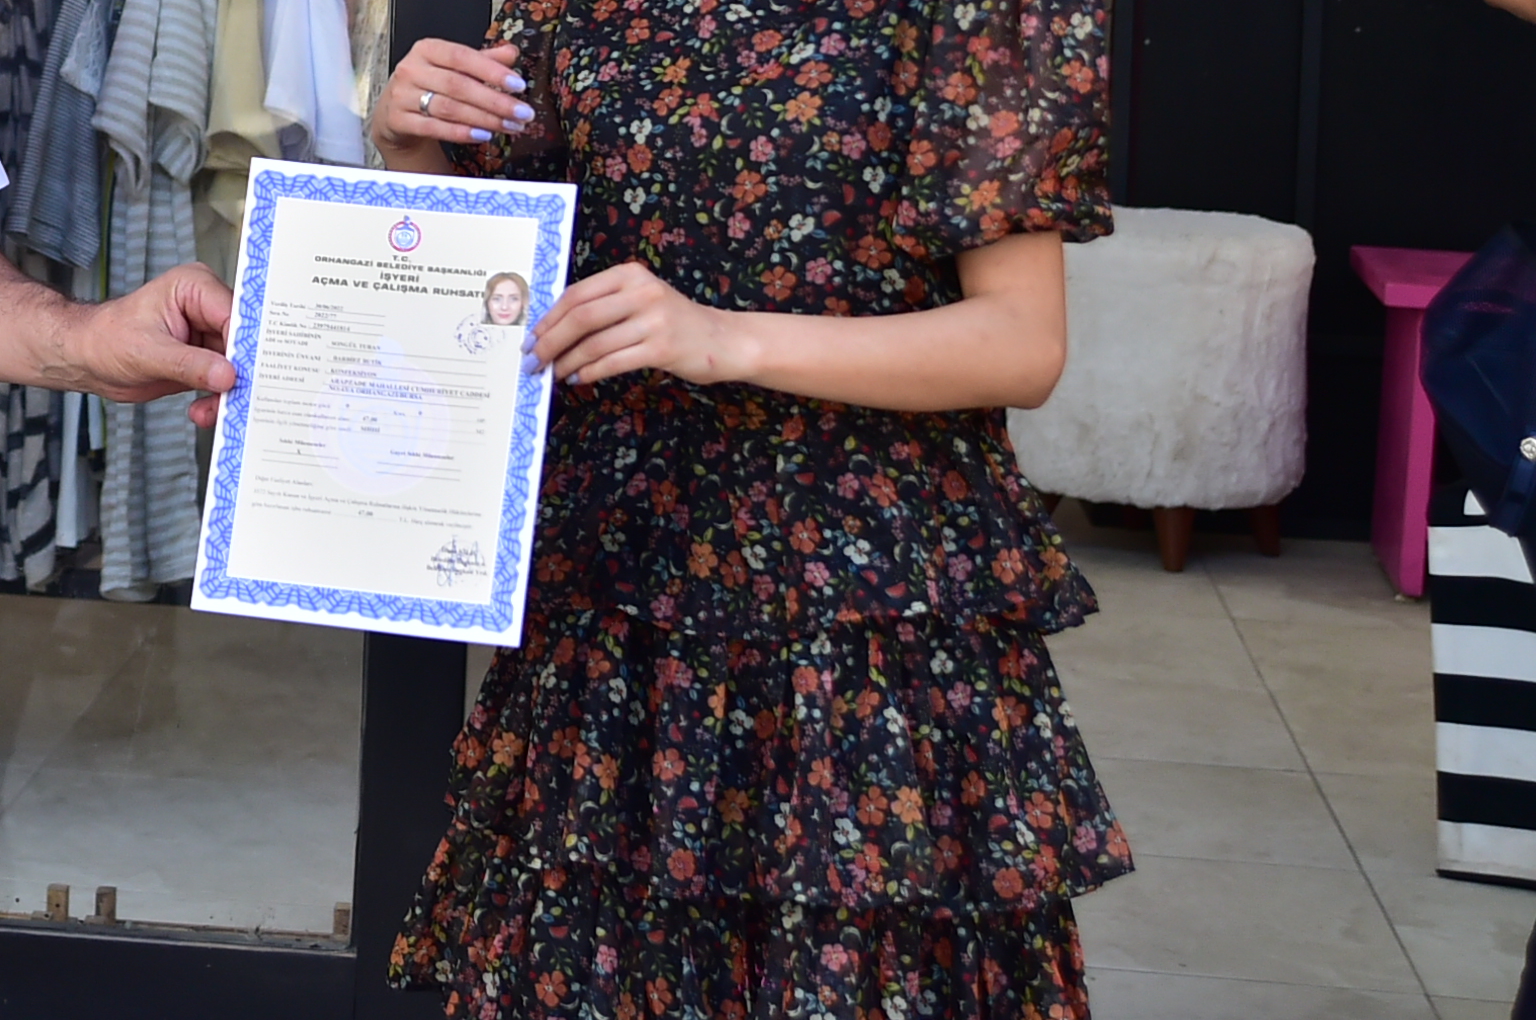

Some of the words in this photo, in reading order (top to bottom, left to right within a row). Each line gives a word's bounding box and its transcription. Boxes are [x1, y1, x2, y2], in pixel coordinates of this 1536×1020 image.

[314, 255, 373, 267] ORHANGAZİ
[376, 261, 424, 272] BELEDİYE
[427, 266, 487, 277] BAŞKANLIĞI
[312, 276, 348, 287] AÇMA
[353, 280, 368, 289] VE
[373, 282, 429, 294] ÇALIŞMA
[380, 271, 420, 283] İŞYERİ
